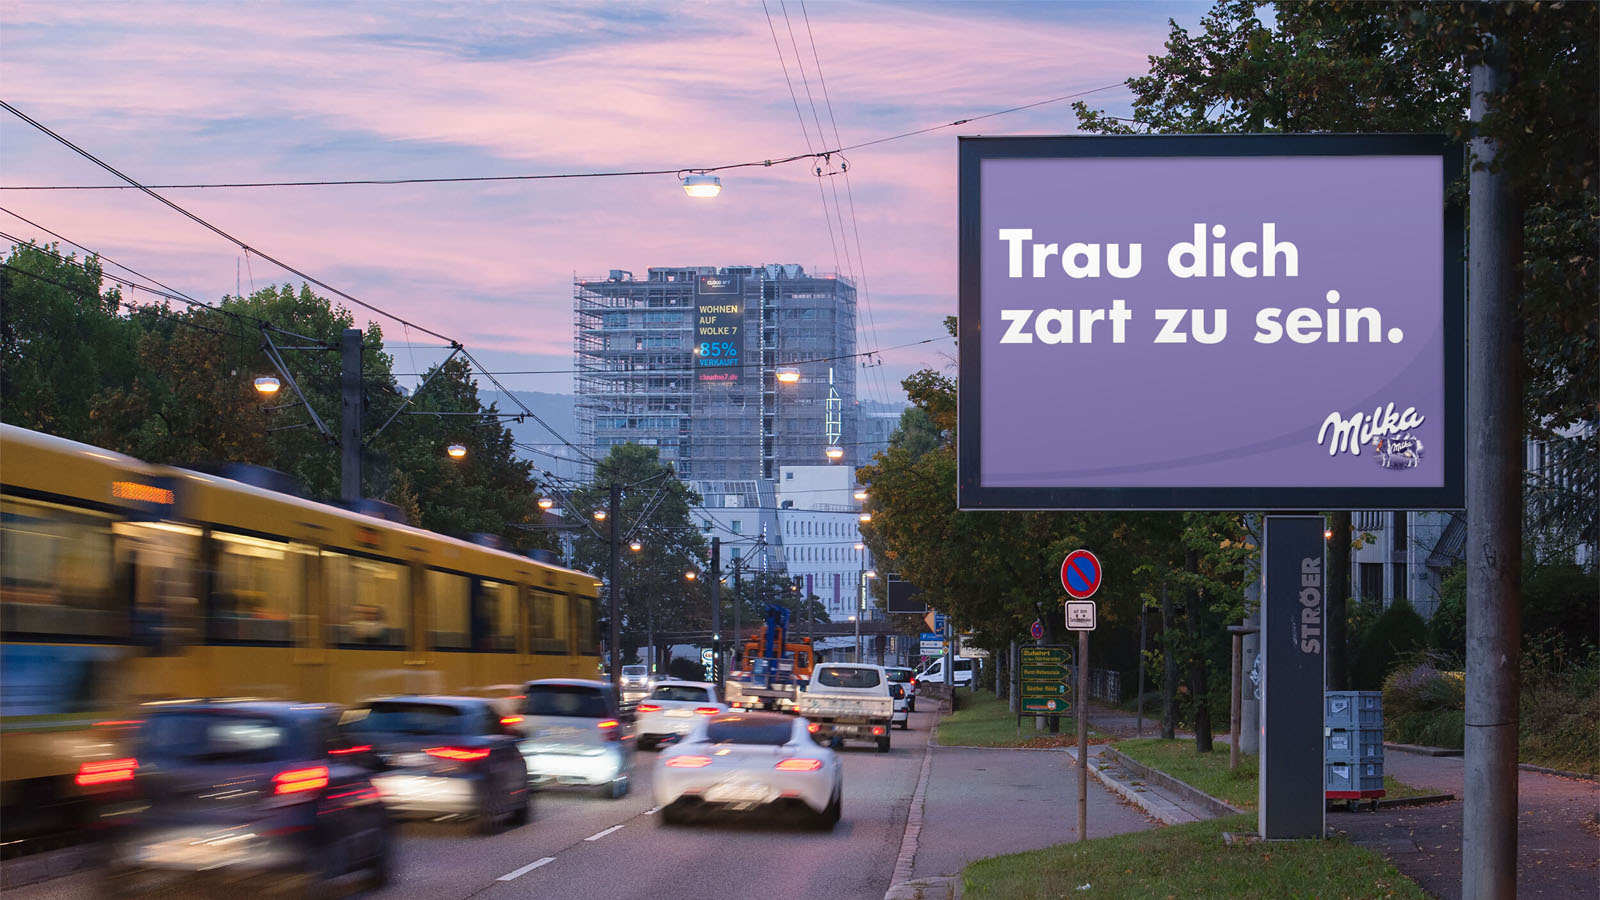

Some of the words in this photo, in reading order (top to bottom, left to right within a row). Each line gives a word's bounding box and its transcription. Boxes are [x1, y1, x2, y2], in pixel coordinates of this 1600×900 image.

[998, 228, 1142, 279] Trau
[1167, 222, 1299, 278] dich
[699, 305, 738, 314] WOHNEN
[699, 316, 717, 325] AUF
[999, 299, 1133, 345] zart
[1153, 308, 1228, 345] zu
[1253, 289, 1405, 345] sein.
[699, 327, 730, 336] WOLKE
[731, 327, 738, 335] 7
[700, 342, 738, 357] 85%
[699, 358, 739, 367] VERKAUFT
[1317, 401, 1426, 457] Milka
[1391, 440, 1412, 453] Milka
[1299, 556, 1321, 655] STRÖER
